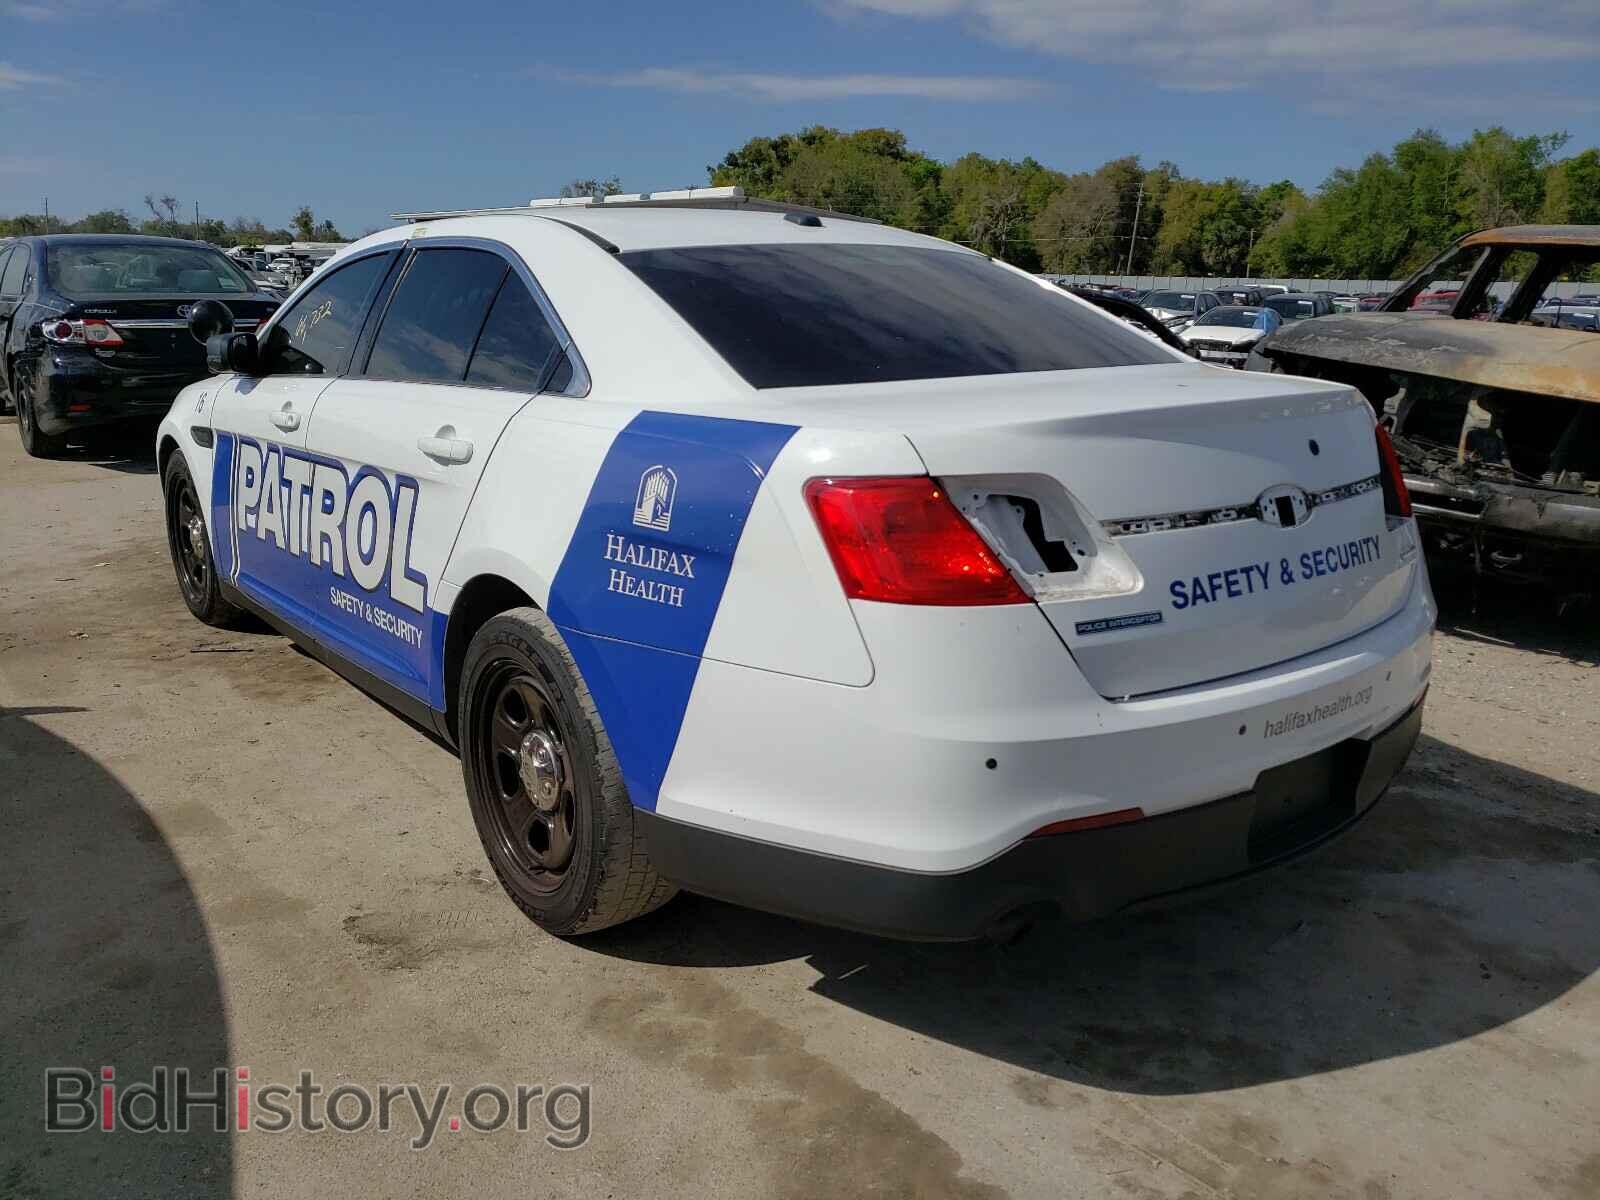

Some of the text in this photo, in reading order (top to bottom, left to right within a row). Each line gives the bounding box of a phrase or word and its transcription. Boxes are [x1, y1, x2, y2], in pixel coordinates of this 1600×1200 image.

[237, 438, 427, 614] PATROL
[603, 533, 697, 578] HALIFAX
[1169, 534, 1382, 610] SAFETY & SECURITY
[607, 567, 686, 608] HEALTH
[330, 586, 423, 649] SAFETY & SECURITY
[1263, 685, 1374, 739] halifaxhealth.org
